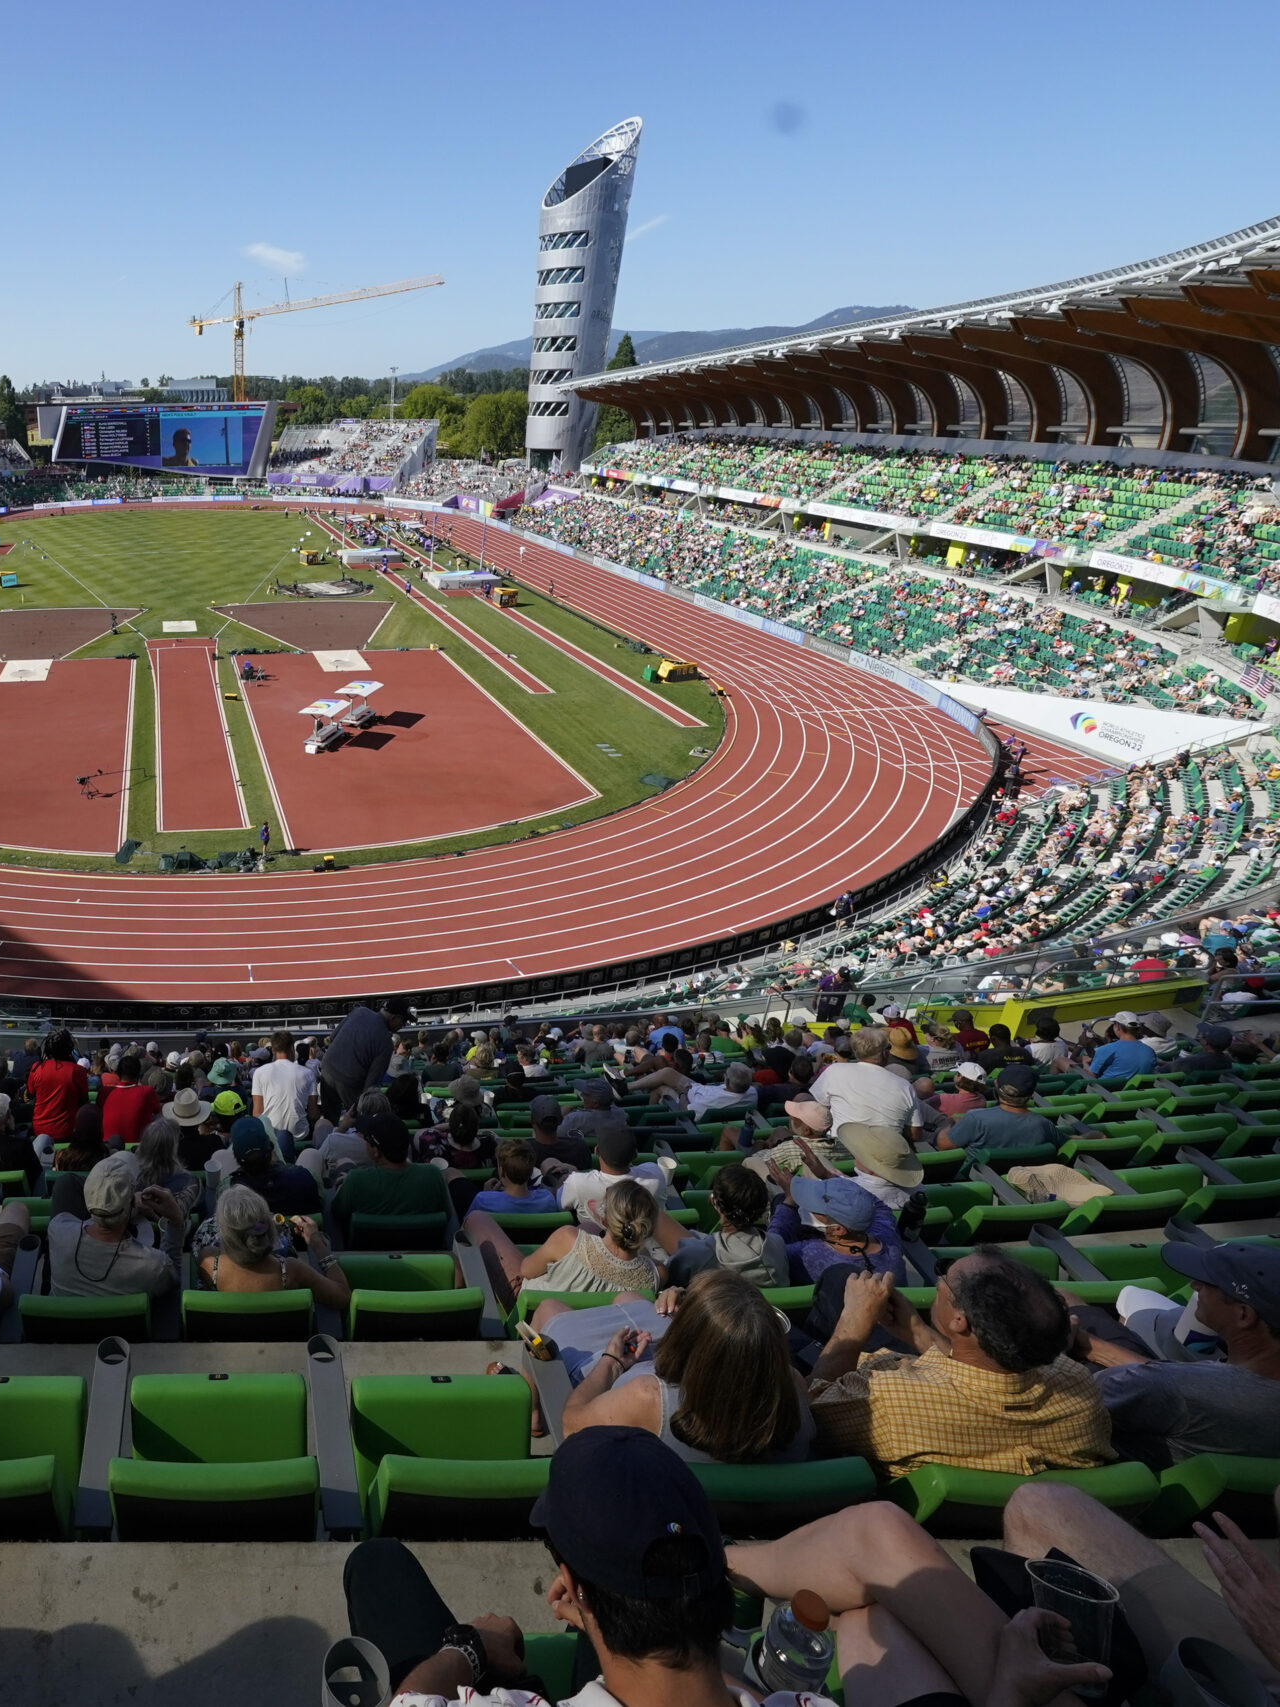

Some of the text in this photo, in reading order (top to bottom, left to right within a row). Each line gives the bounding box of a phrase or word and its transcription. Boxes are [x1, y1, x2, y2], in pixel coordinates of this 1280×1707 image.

[769, 623, 802, 642] MONDO
[864, 657, 895, 680] Nielsen
[946, 702, 976, 730] MONDO
